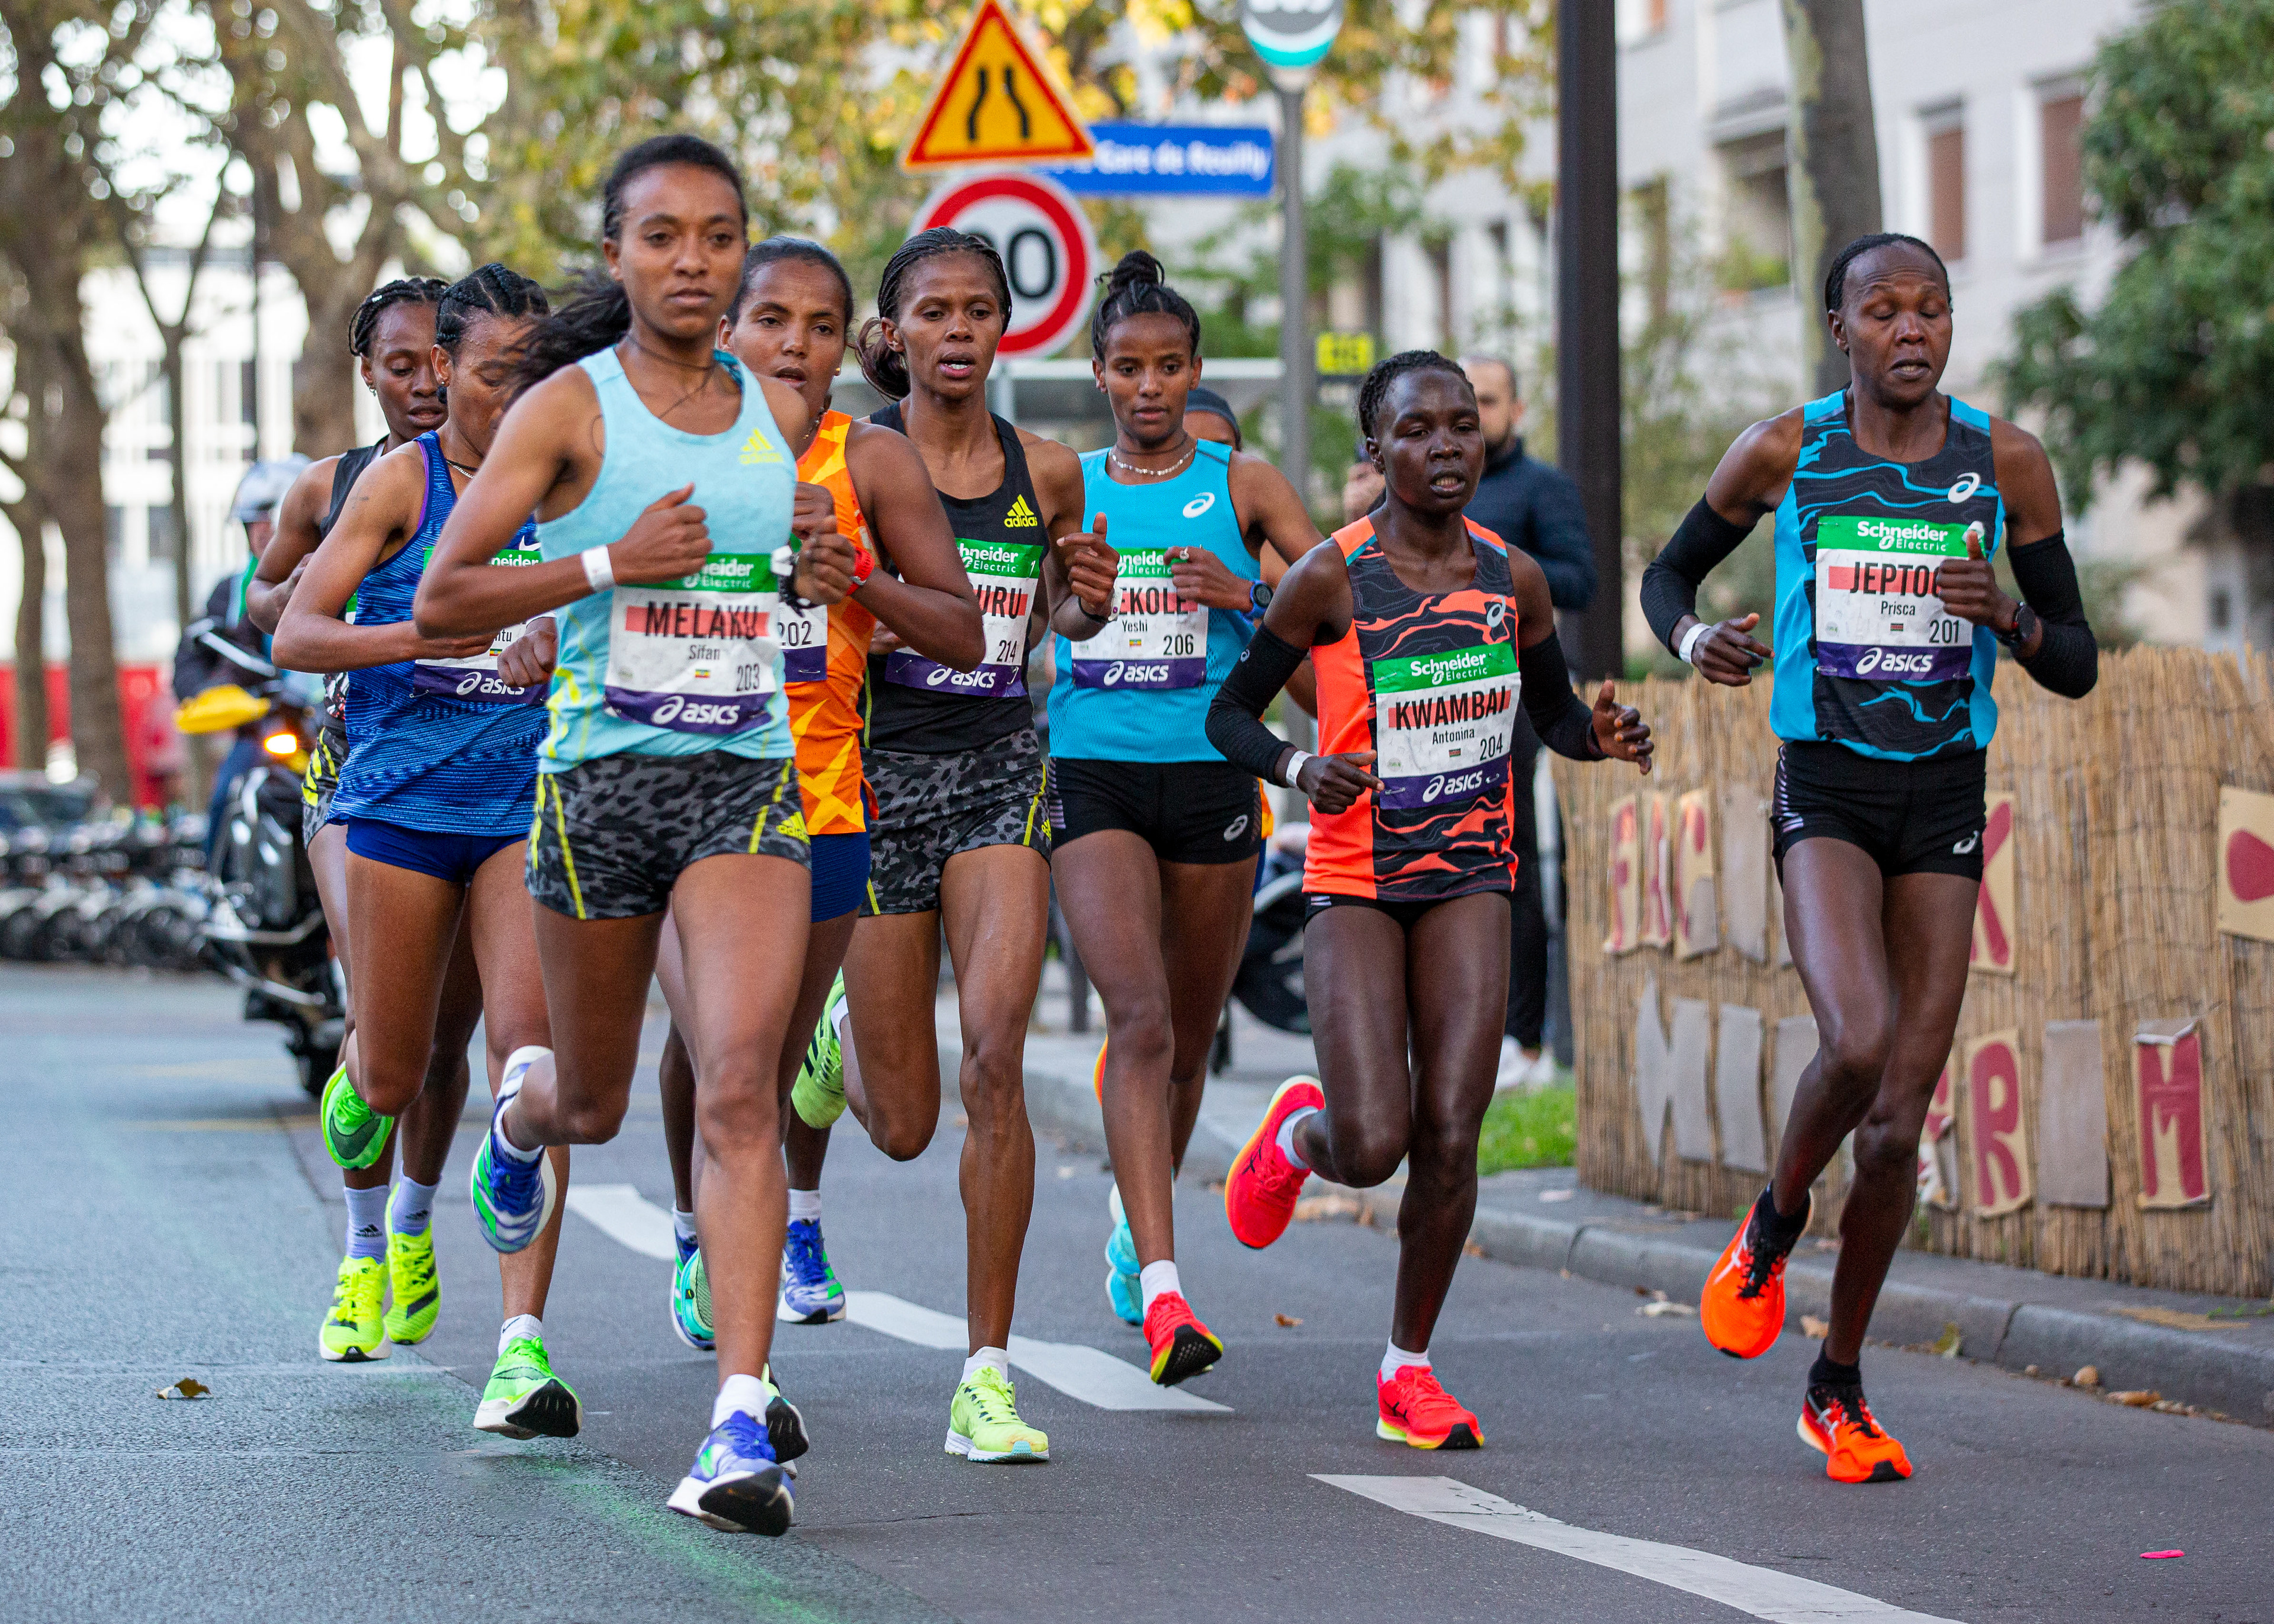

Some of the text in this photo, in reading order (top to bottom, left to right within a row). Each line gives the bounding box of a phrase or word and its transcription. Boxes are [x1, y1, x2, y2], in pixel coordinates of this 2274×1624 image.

[1857, 521, 1948, 542] Schneider
[957, 542, 1019, 563] hneider
[1896, 541, 1947, 552] Electric
[974, 559, 1017, 573] Electric
[1119, 551, 1164, 566] neide
[1881, 600, 1916, 616] Prisca
[645, 600, 759, 641] MELAKU
[1122, 619, 1148, 632] Yeshi
[778, 620, 812, 647] 202
[1928, 619, 1960, 644] 201
[689, 644, 721, 661] Sifan
[996, 639, 1018, 663] 214
[1163, 633, 1194, 656] 206
[1410, 652, 1487, 677] Schneider
[1880, 652, 1933, 673] asics
[735, 663, 761, 692] 203
[950, 670, 997, 689] asics
[1124, 664, 1170, 683] asics
[1446, 666, 1488, 681] Electric
[680, 703, 741, 725] asics
[1396, 685, 1507, 731] KWAMBAI
[1432, 726, 1475, 745] Antonina
[1479, 732, 1504, 761] 204
[1444, 770, 1483, 796] asics
